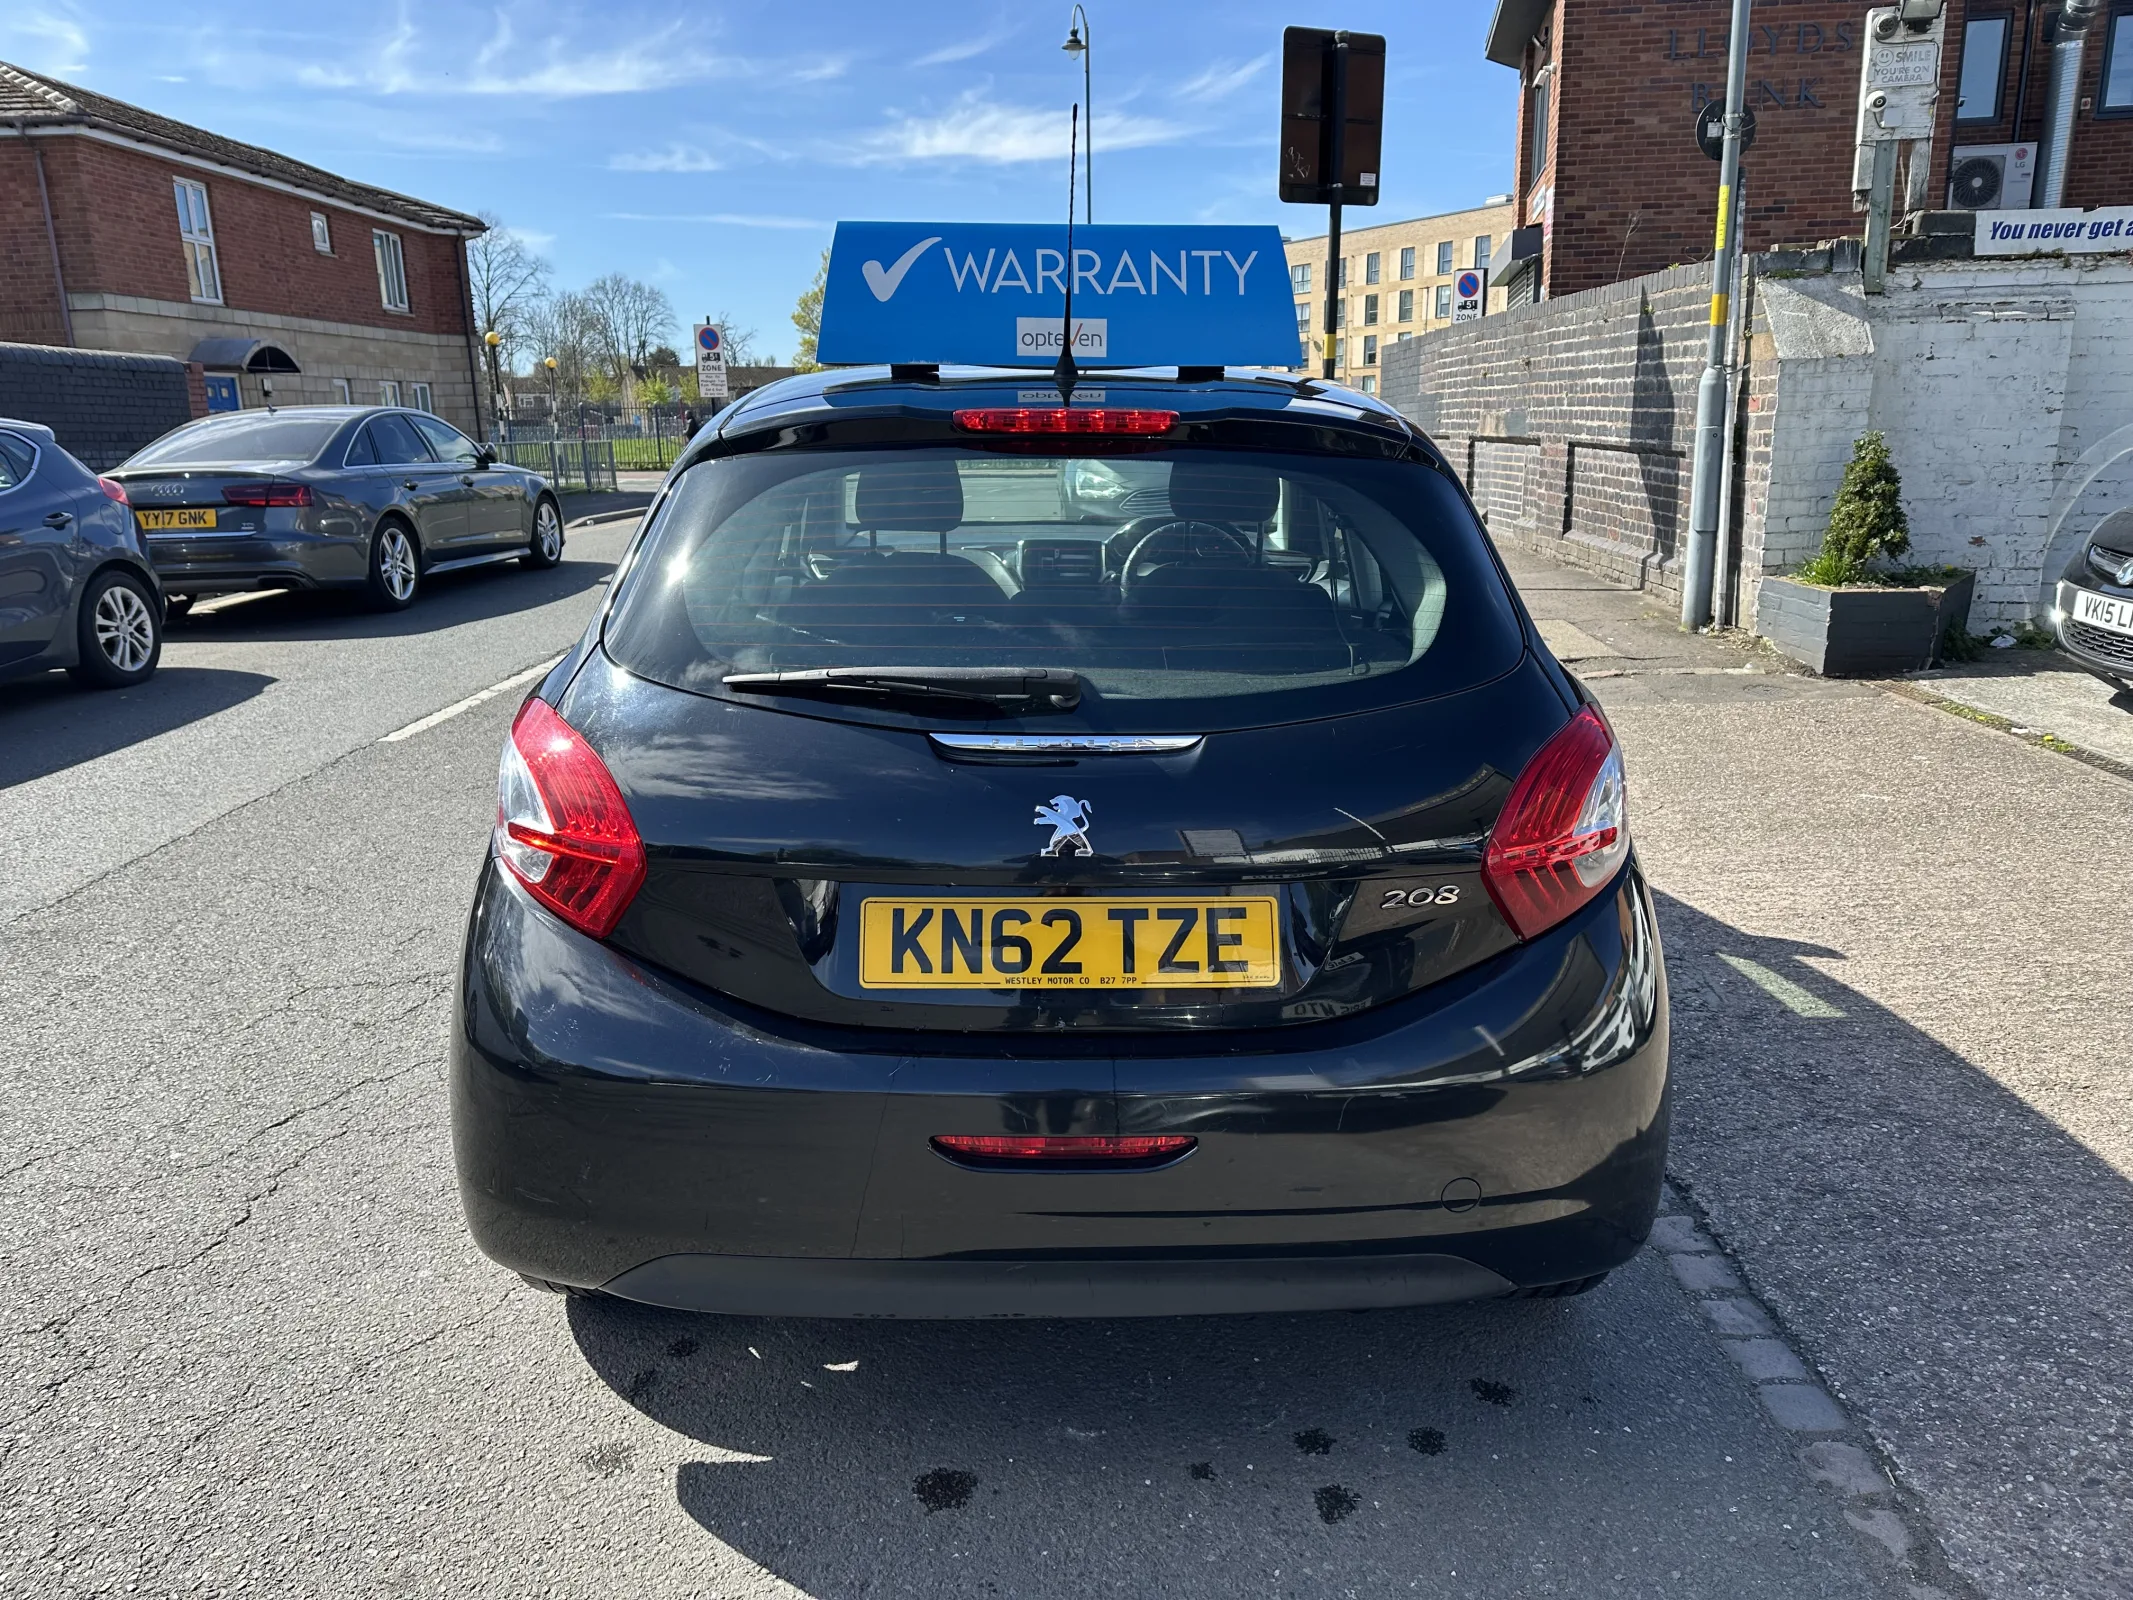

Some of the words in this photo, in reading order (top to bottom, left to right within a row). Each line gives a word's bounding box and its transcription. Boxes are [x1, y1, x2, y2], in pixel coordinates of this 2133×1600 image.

[1896, 50, 1931, 63] SMILE
[1874, 66, 1911, 76] YOU'RE
[1913, 65, 1930, 73] ON
[1881, 74, 1922, 83] CAMERA
[1692, 77, 1827, 113] BNK
[1990, 220, 2026, 240] You
[2027, 222, 2087, 239] never
[2087, 218, 2124, 240] get
[943, 247, 1258, 296] WARRANTY
[142, 511, 174, 526] YY17
[178, 511, 207, 525] GNK
[2085, 595, 2116, 624] VK15
[991, 739, 1143, 748] PEUGEOT
[1381, 885, 1460, 909] 208
[891, 907, 1083, 974] KN62
[1107, 907, 1249, 974] TZE
